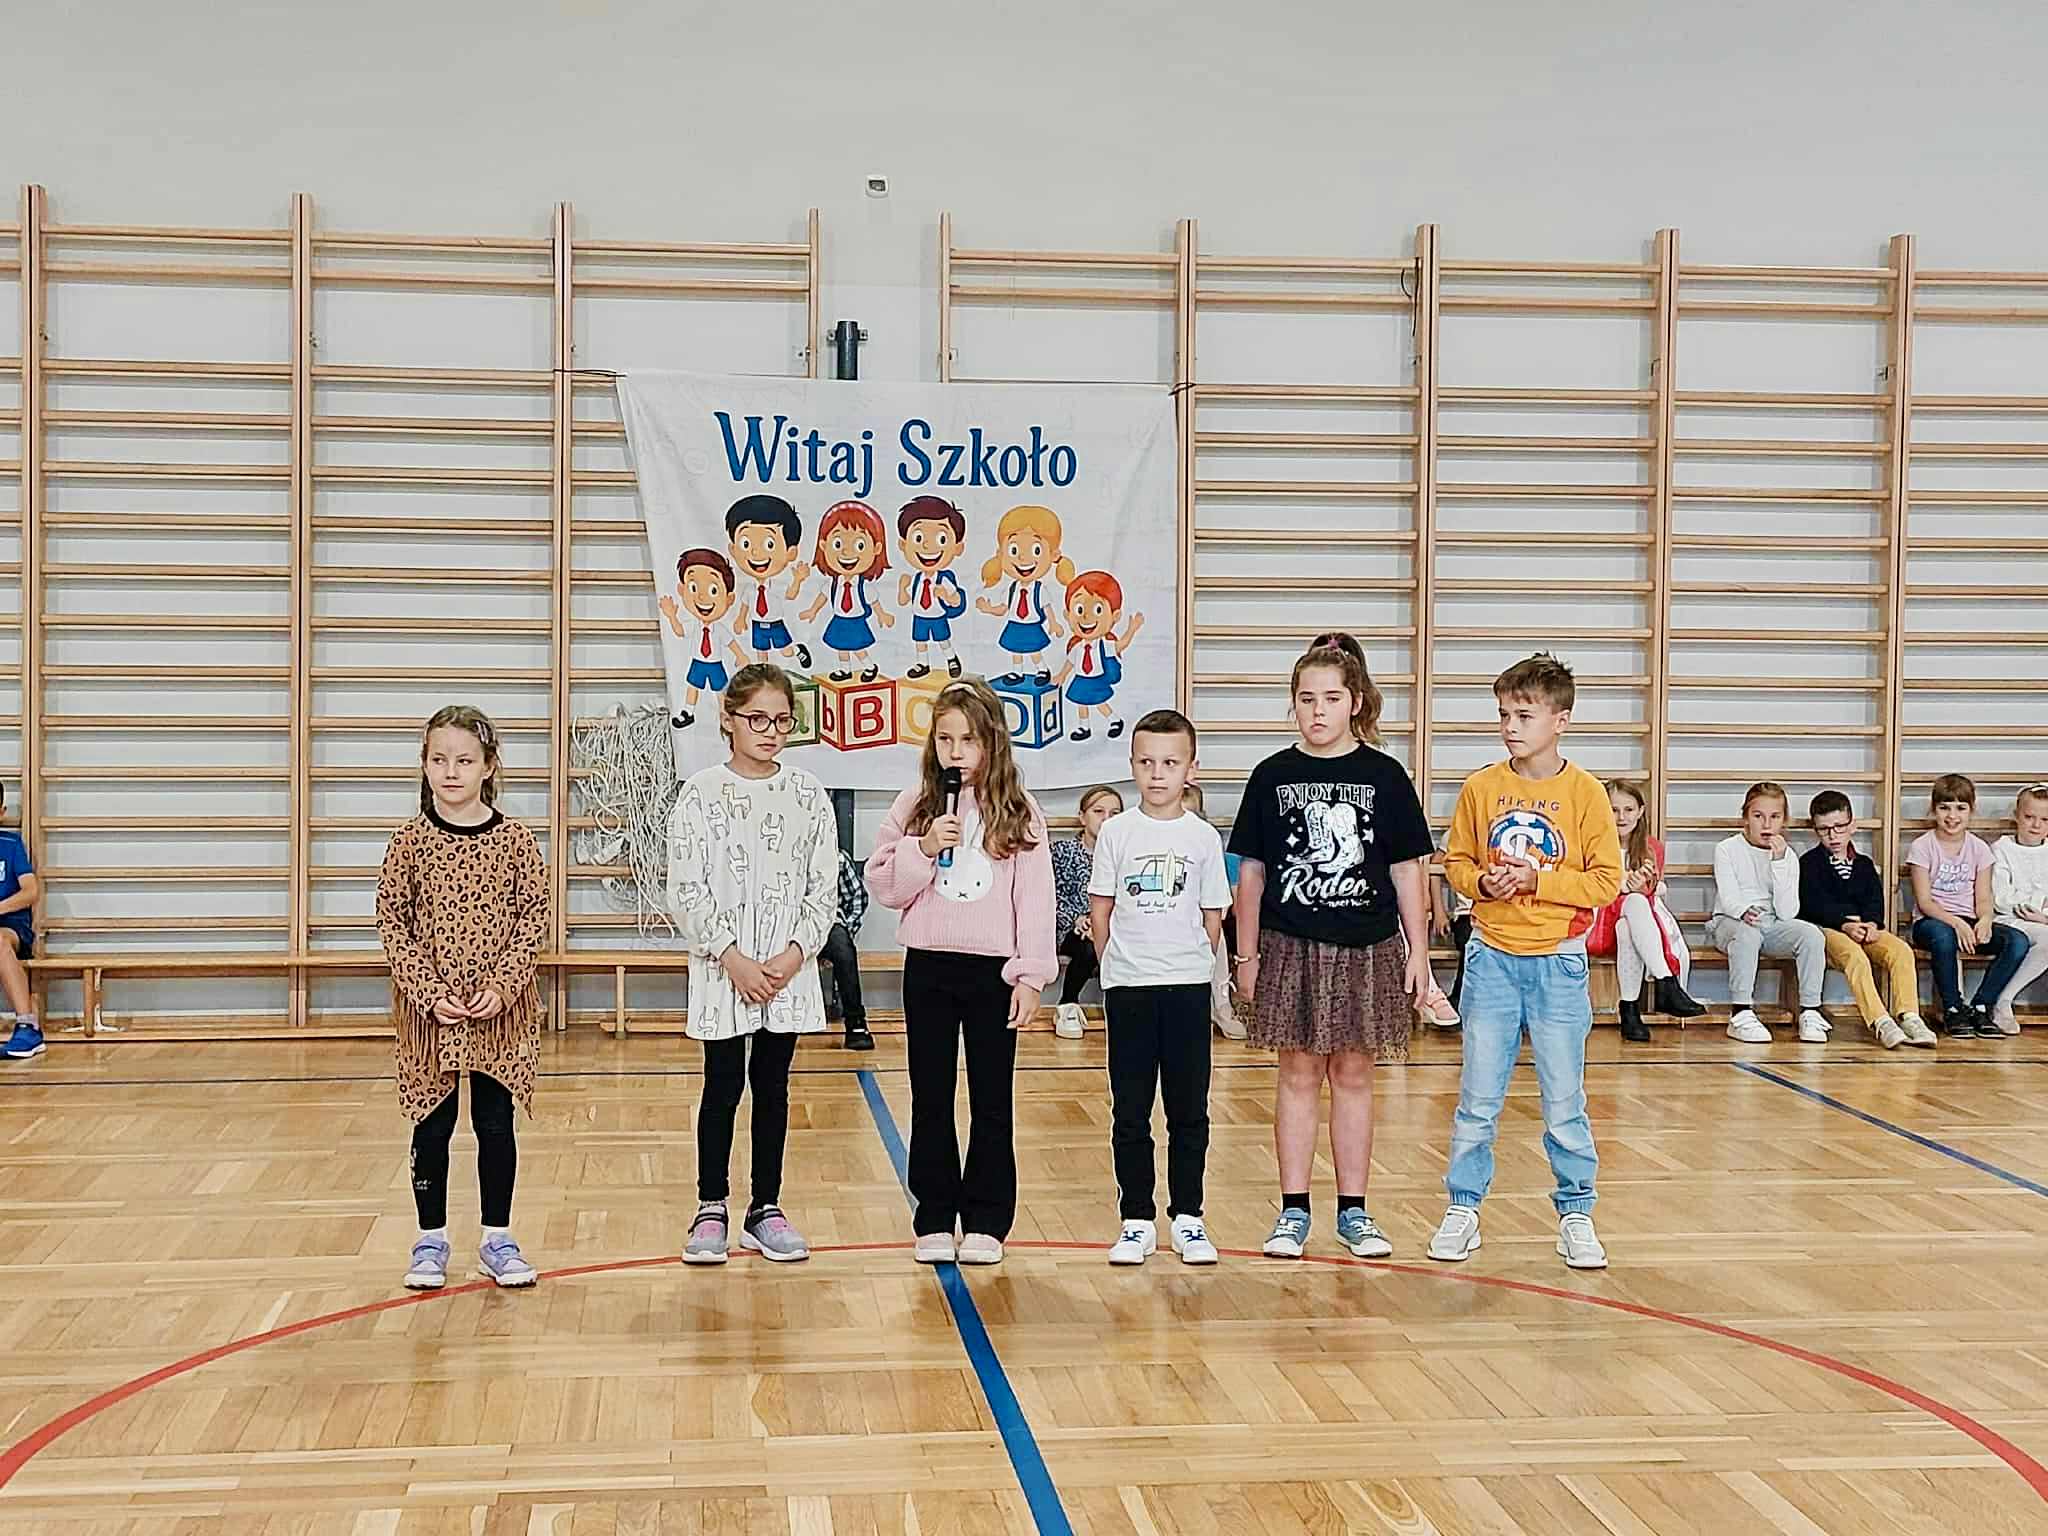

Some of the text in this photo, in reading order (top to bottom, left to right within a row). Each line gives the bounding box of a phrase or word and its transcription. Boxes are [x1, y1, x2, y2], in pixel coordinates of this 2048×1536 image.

[713, 411, 1077, 498] Witaj Szkoło
[822, 692, 835, 733] b
[852, 695, 885, 738] B
[1043, 701, 1057, 733] d
[1276, 783, 1376, 816] ENJOY THE
[1497, 795, 1561, 811] HIKING
[1280, 864, 1370, 905] Rodeo
